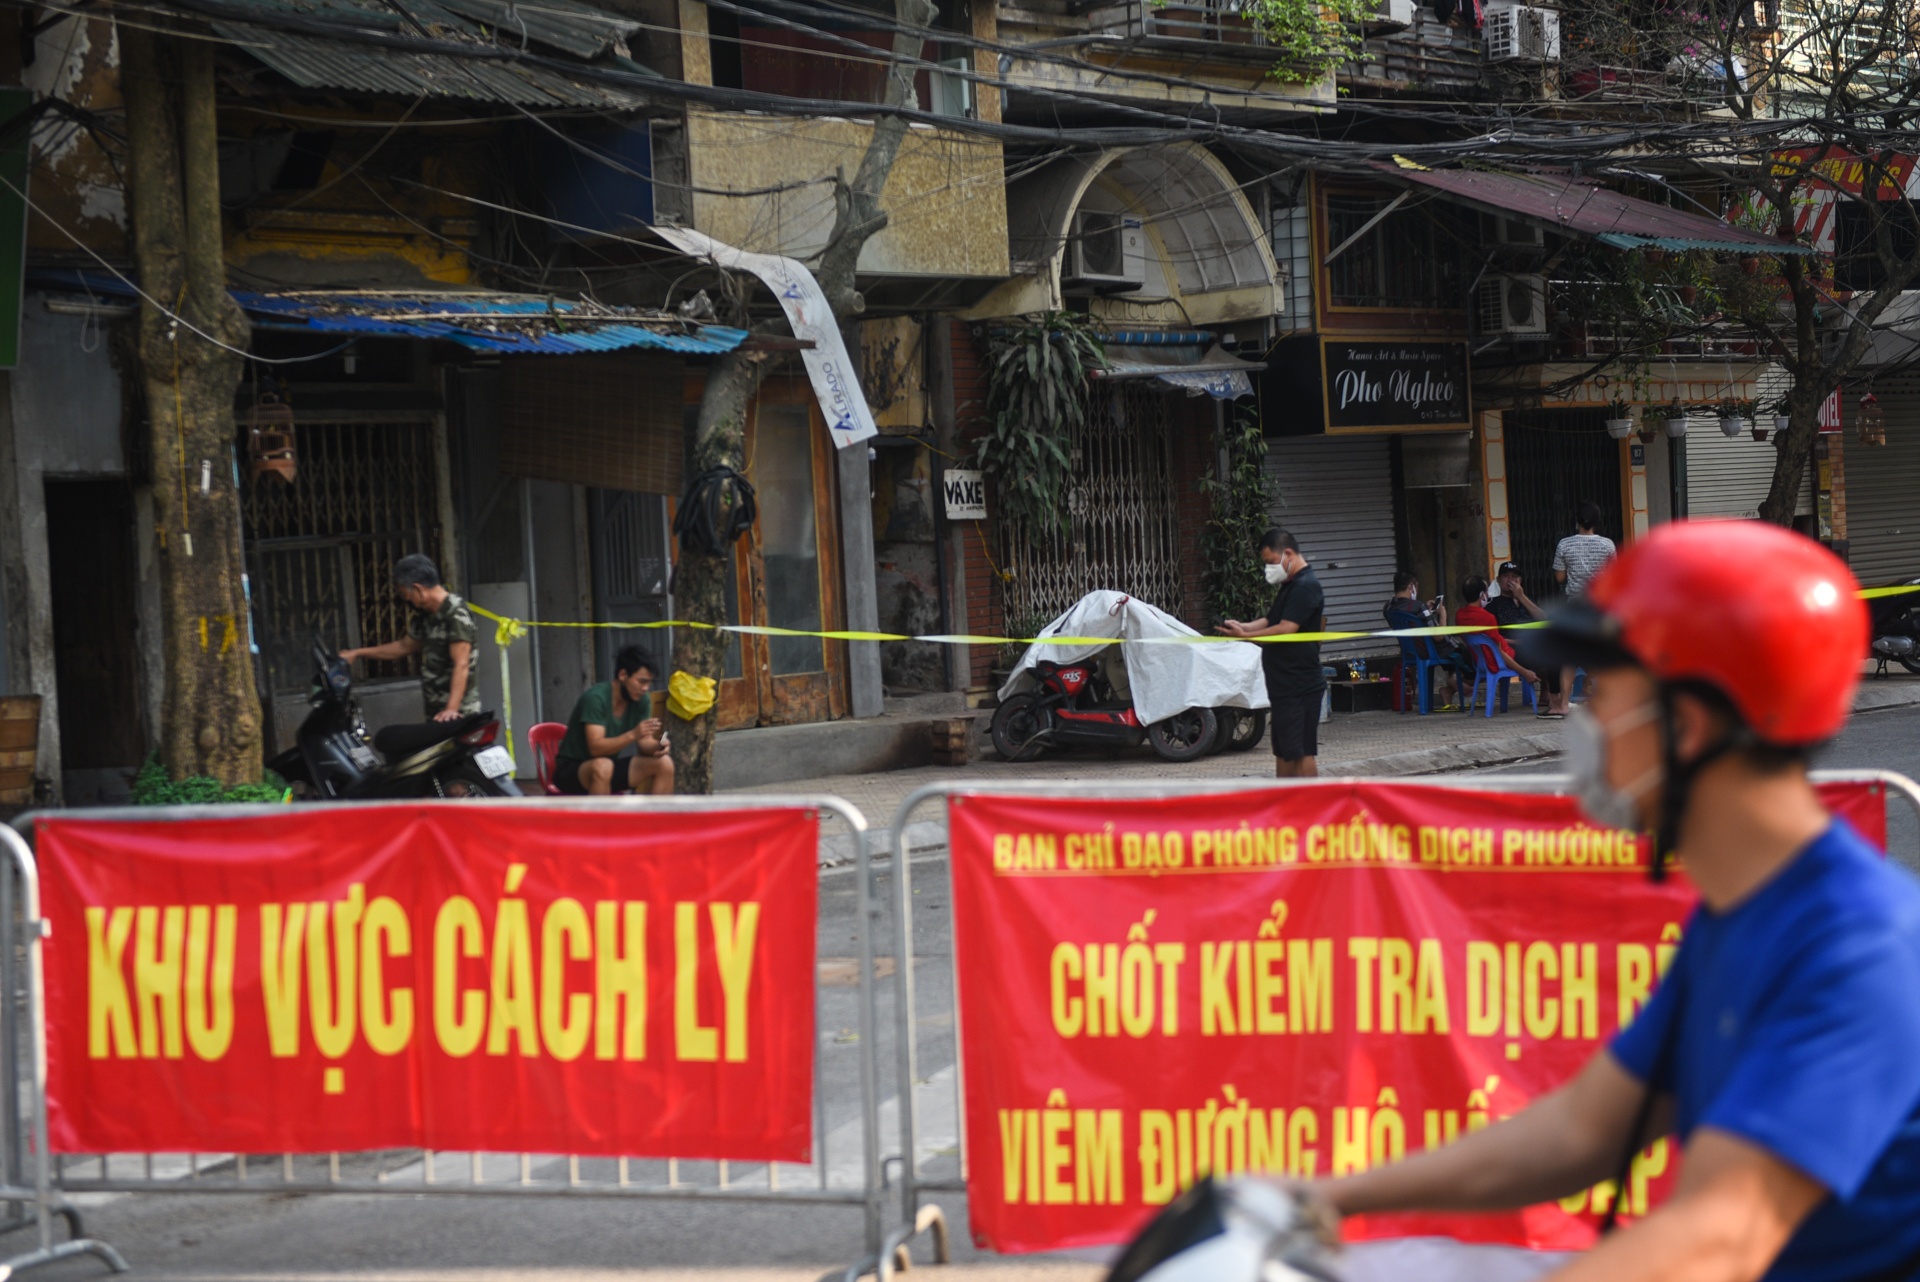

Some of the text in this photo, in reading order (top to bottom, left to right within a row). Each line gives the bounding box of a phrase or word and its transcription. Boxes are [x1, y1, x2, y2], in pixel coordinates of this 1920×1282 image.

[1334, 369, 1384, 410] Pho
[993, 833, 1057, 871] BAN
[1063, 821, 1117, 869] CHỈ
[1121, 831, 1184, 877] ĐẠO
[1191, 819, 1299, 866] PHÒNG
[1306, 809, 1411, 862] CHỐNG
[1418, 826, 1494, 873] DỊCH
[1502, 821, 1637, 865] PHƯỜNG
[85, 863, 761, 1095] KHU VỰC CÁCH LY
[1050, 908, 1186, 1039] CHỐT
[1200, 899, 1335, 1036] KIỂM
[1347, 937, 1451, 1036] TRA
[1466, 940, 1600, 1061] DỊCH
[998, 1088, 1125, 1206] VIÊM
[1332, 1087, 1406, 1182] HÔ
